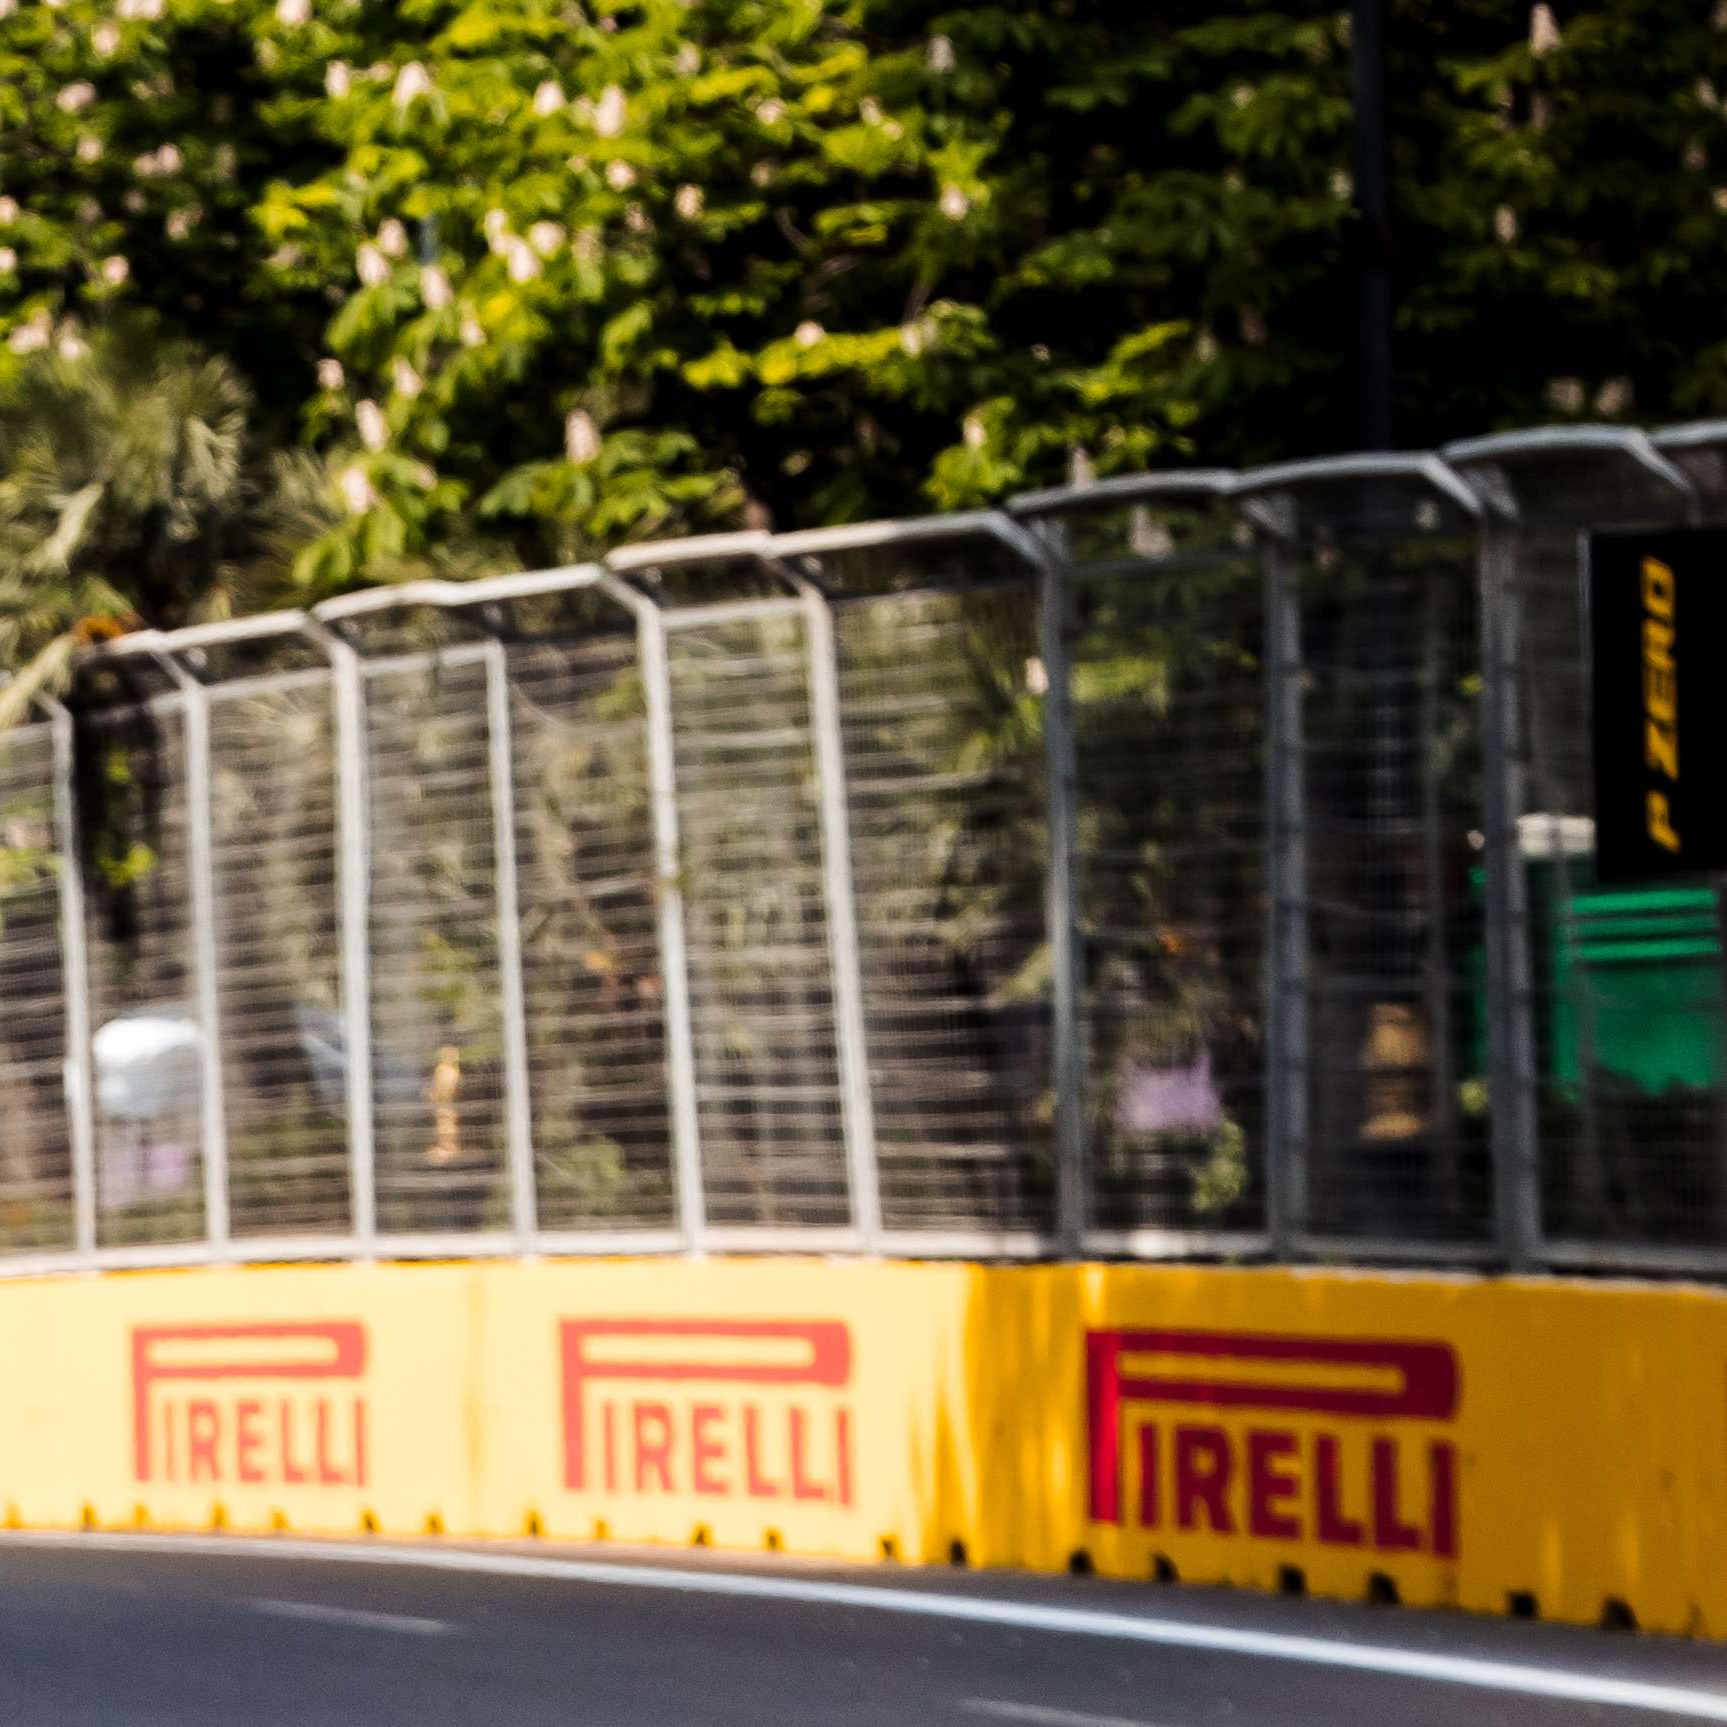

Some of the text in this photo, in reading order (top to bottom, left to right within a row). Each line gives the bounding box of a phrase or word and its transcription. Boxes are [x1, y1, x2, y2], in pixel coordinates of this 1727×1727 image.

[132, 1321, 369, 1488] PIRELLI
[559, 1318, 852, 1507] PIRELLI
[1084, 1328, 1461, 1558] PIRELLI
